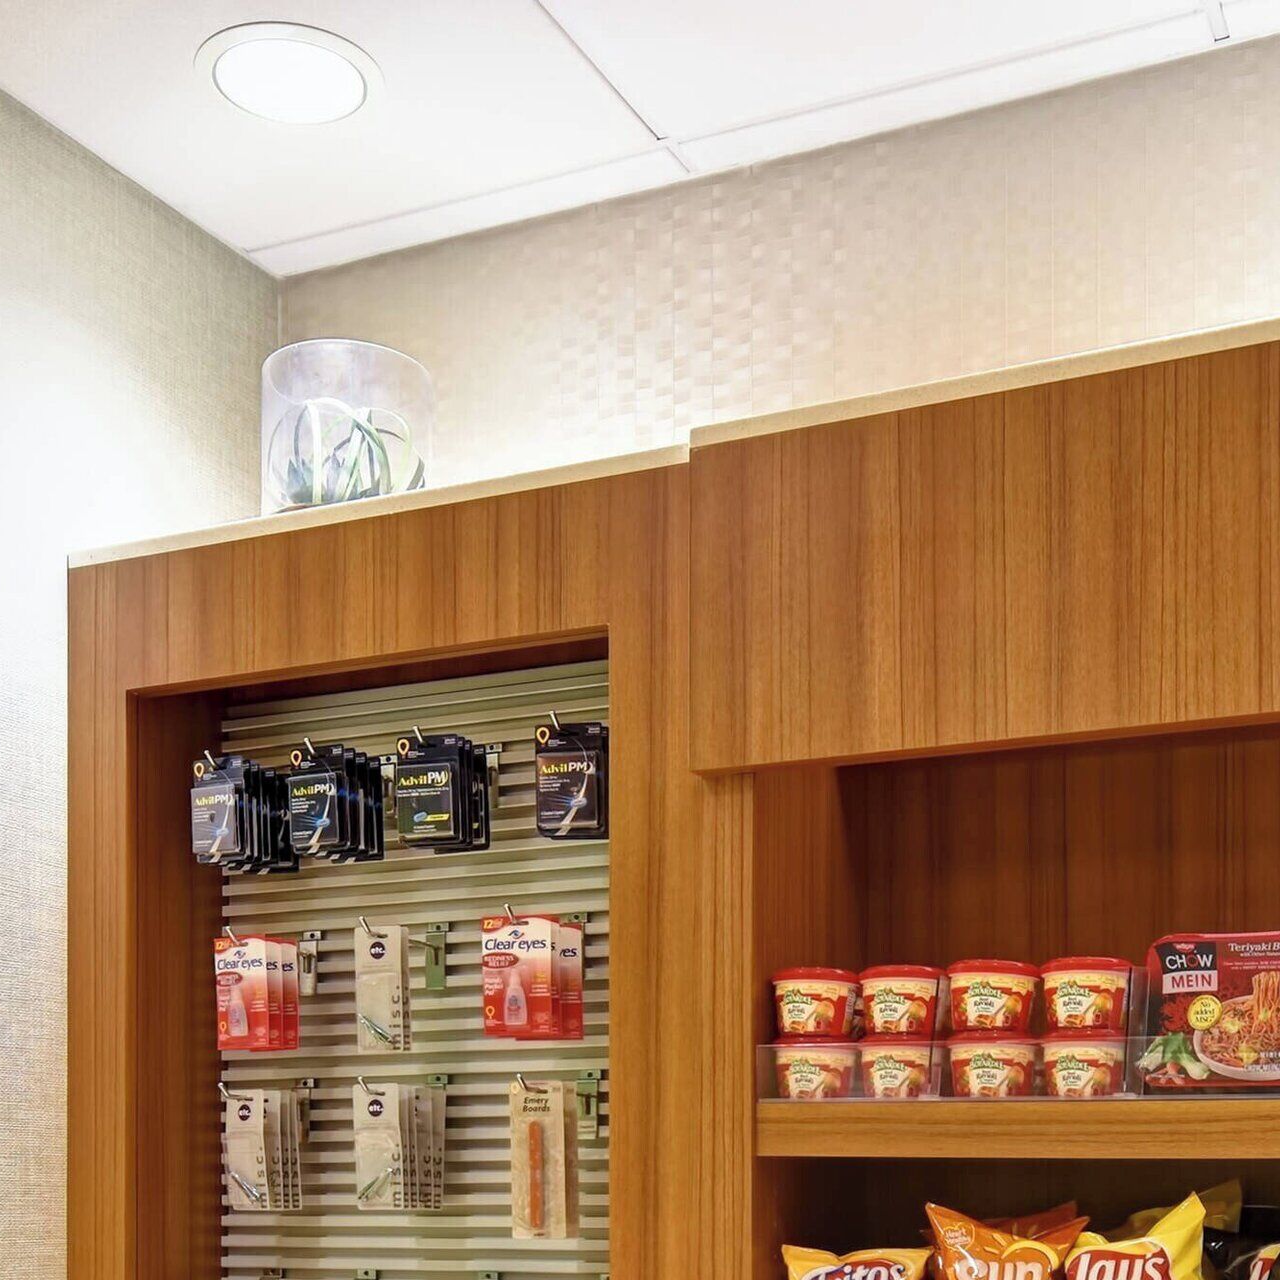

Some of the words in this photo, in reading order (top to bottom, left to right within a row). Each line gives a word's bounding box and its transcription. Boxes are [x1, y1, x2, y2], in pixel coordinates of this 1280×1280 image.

[485, 939, 516, 950] Clear
[518, 940, 546, 952] eyes
[1228, 943, 1271, 952] Teriyaki
[217, 959, 240, 970] Clear
[242, 959, 262, 970] eyes
[1166, 954, 1213, 969] CHOW
[1171, 974, 1212, 988] MEIN
[522, 1105, 551, 1113] Boards
[523, 1097, 549, 1109] Emery
